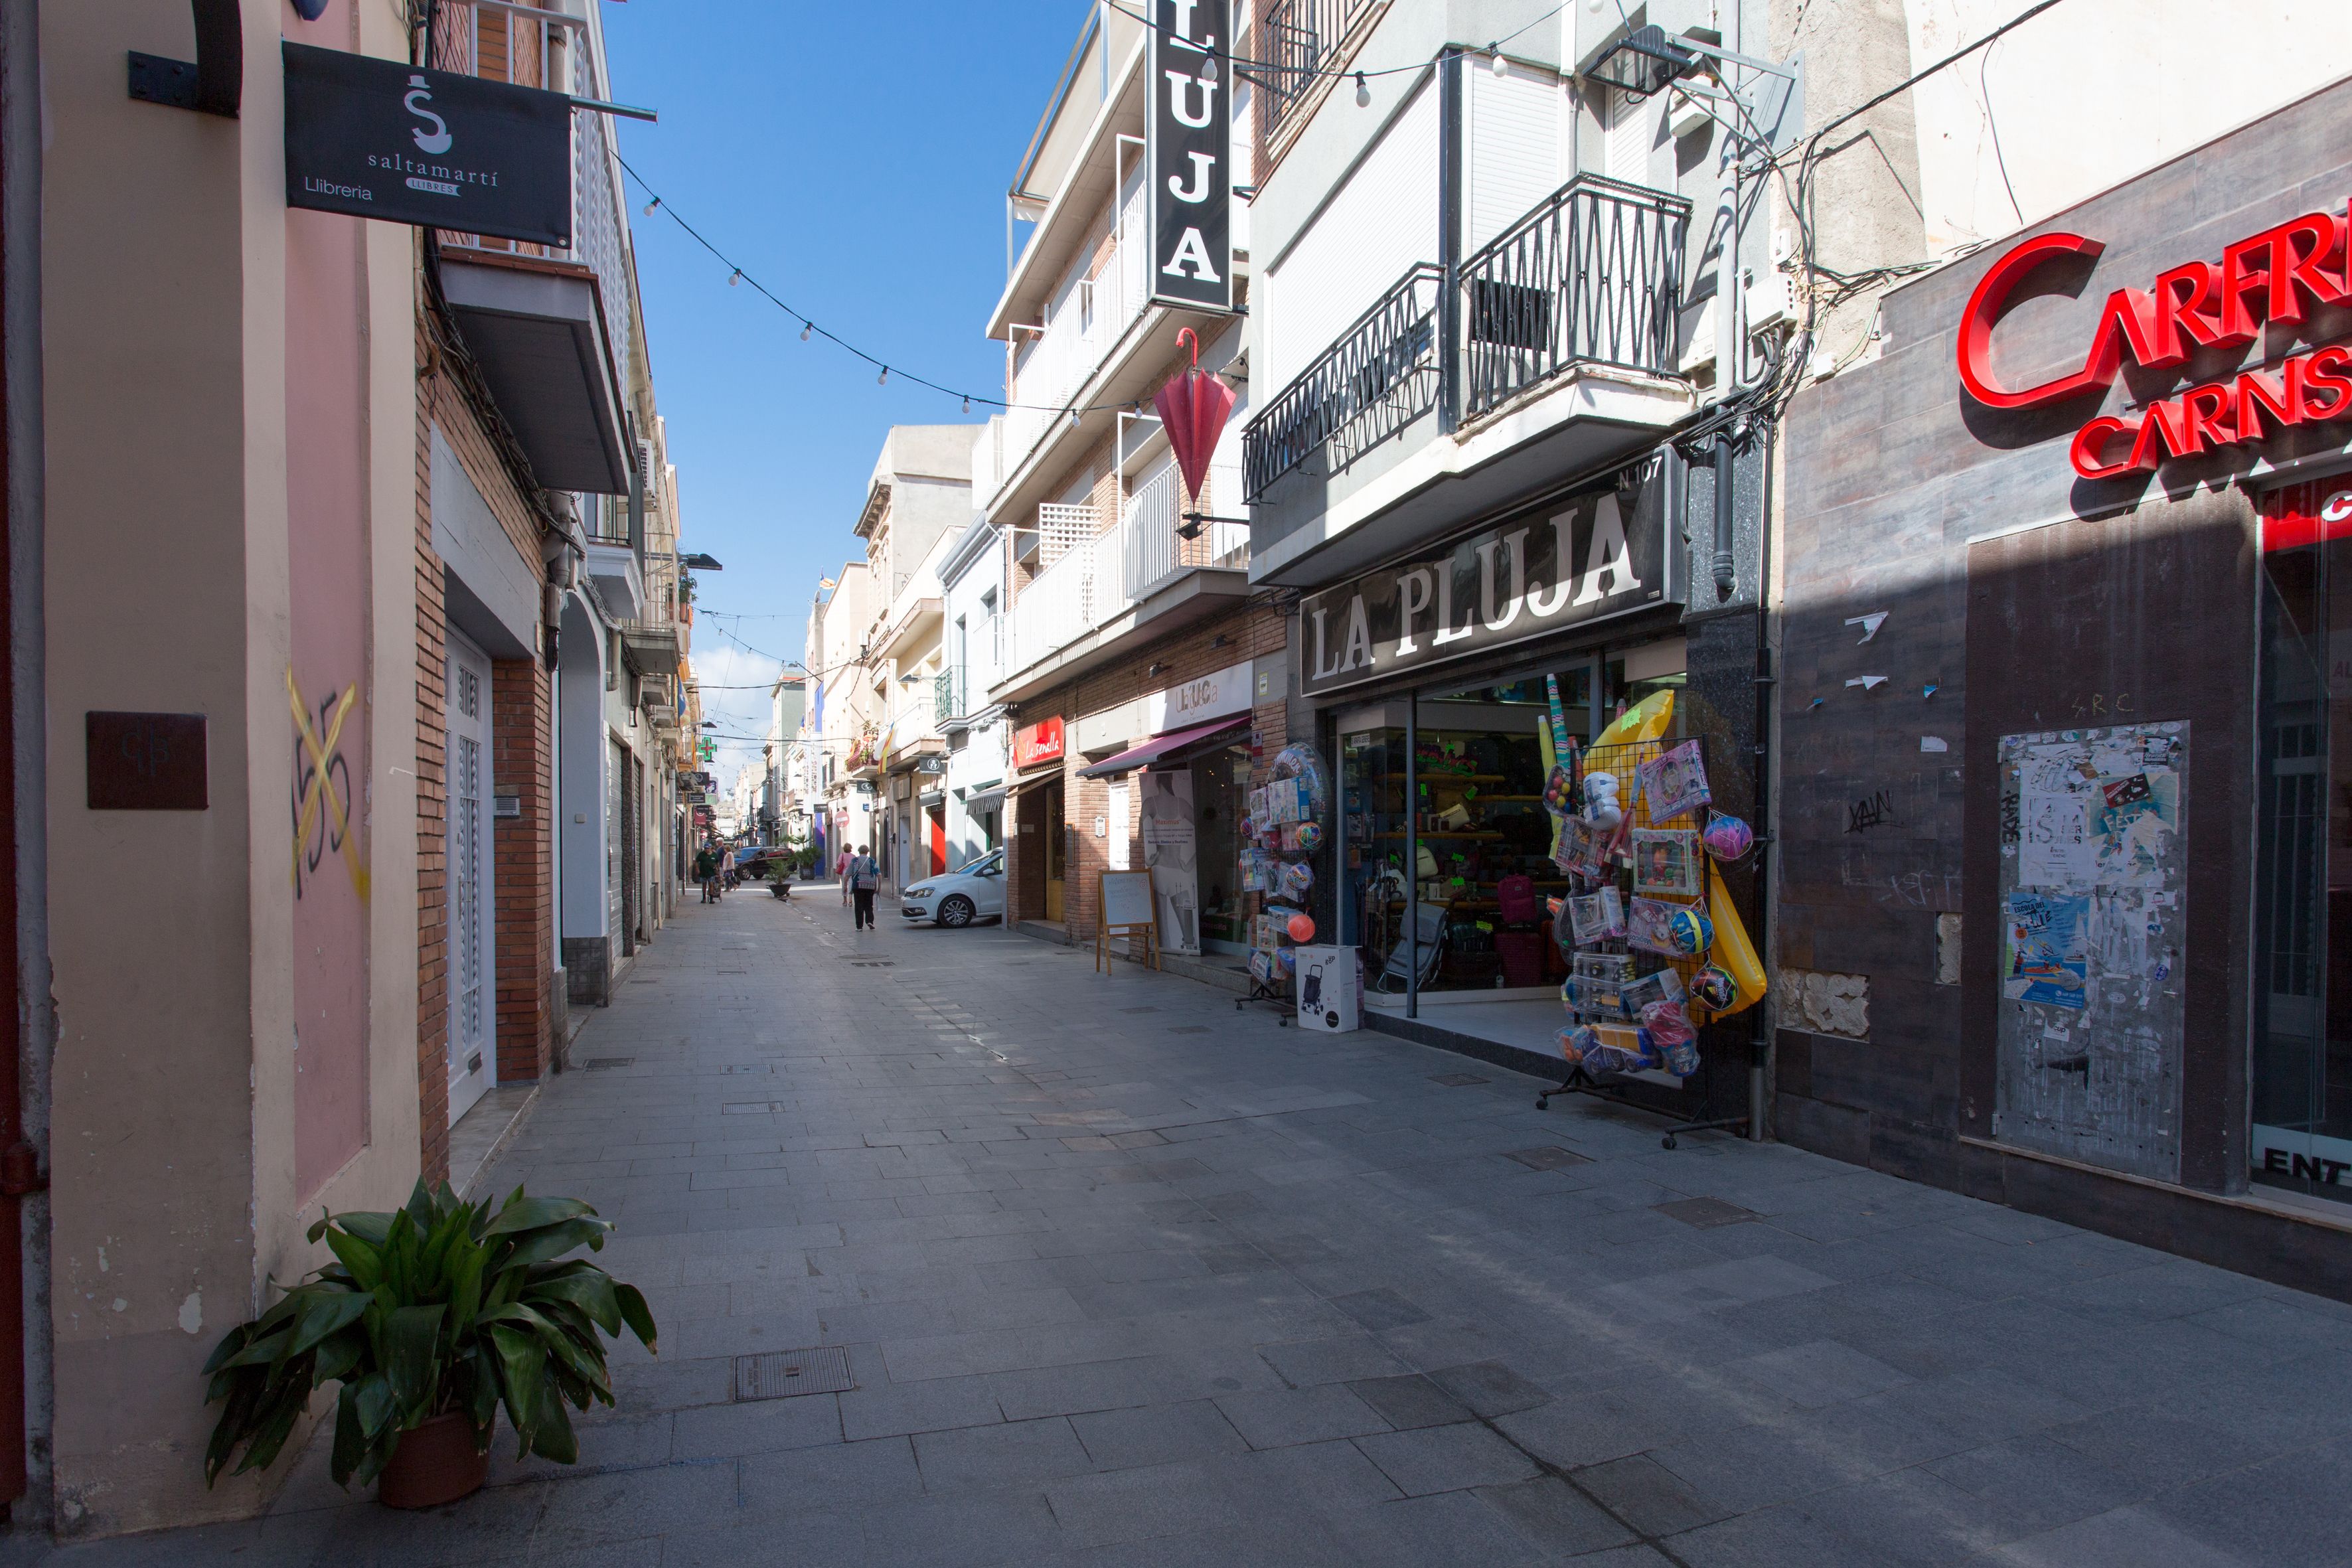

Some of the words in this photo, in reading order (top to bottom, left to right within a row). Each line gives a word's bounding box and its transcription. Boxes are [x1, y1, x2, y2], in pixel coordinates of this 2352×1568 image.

[368, 153, 499, 188] saltamartí
[305, 176, 372, 202] Llibreria
[412, 179, 455, 195] LLIBRES
[1956, 197, 2352, 410] CARFR
[1634, 455, 1663, 485] 107
[1312, 594, 1376, 680] LA
[1395, 492, 1641, 657] PLUJA
[1026, 741, 1034, 759] La
[2014, 903, 2035, 913] ESCOLA
[2264, 1146, 2351, 1185] ENT
